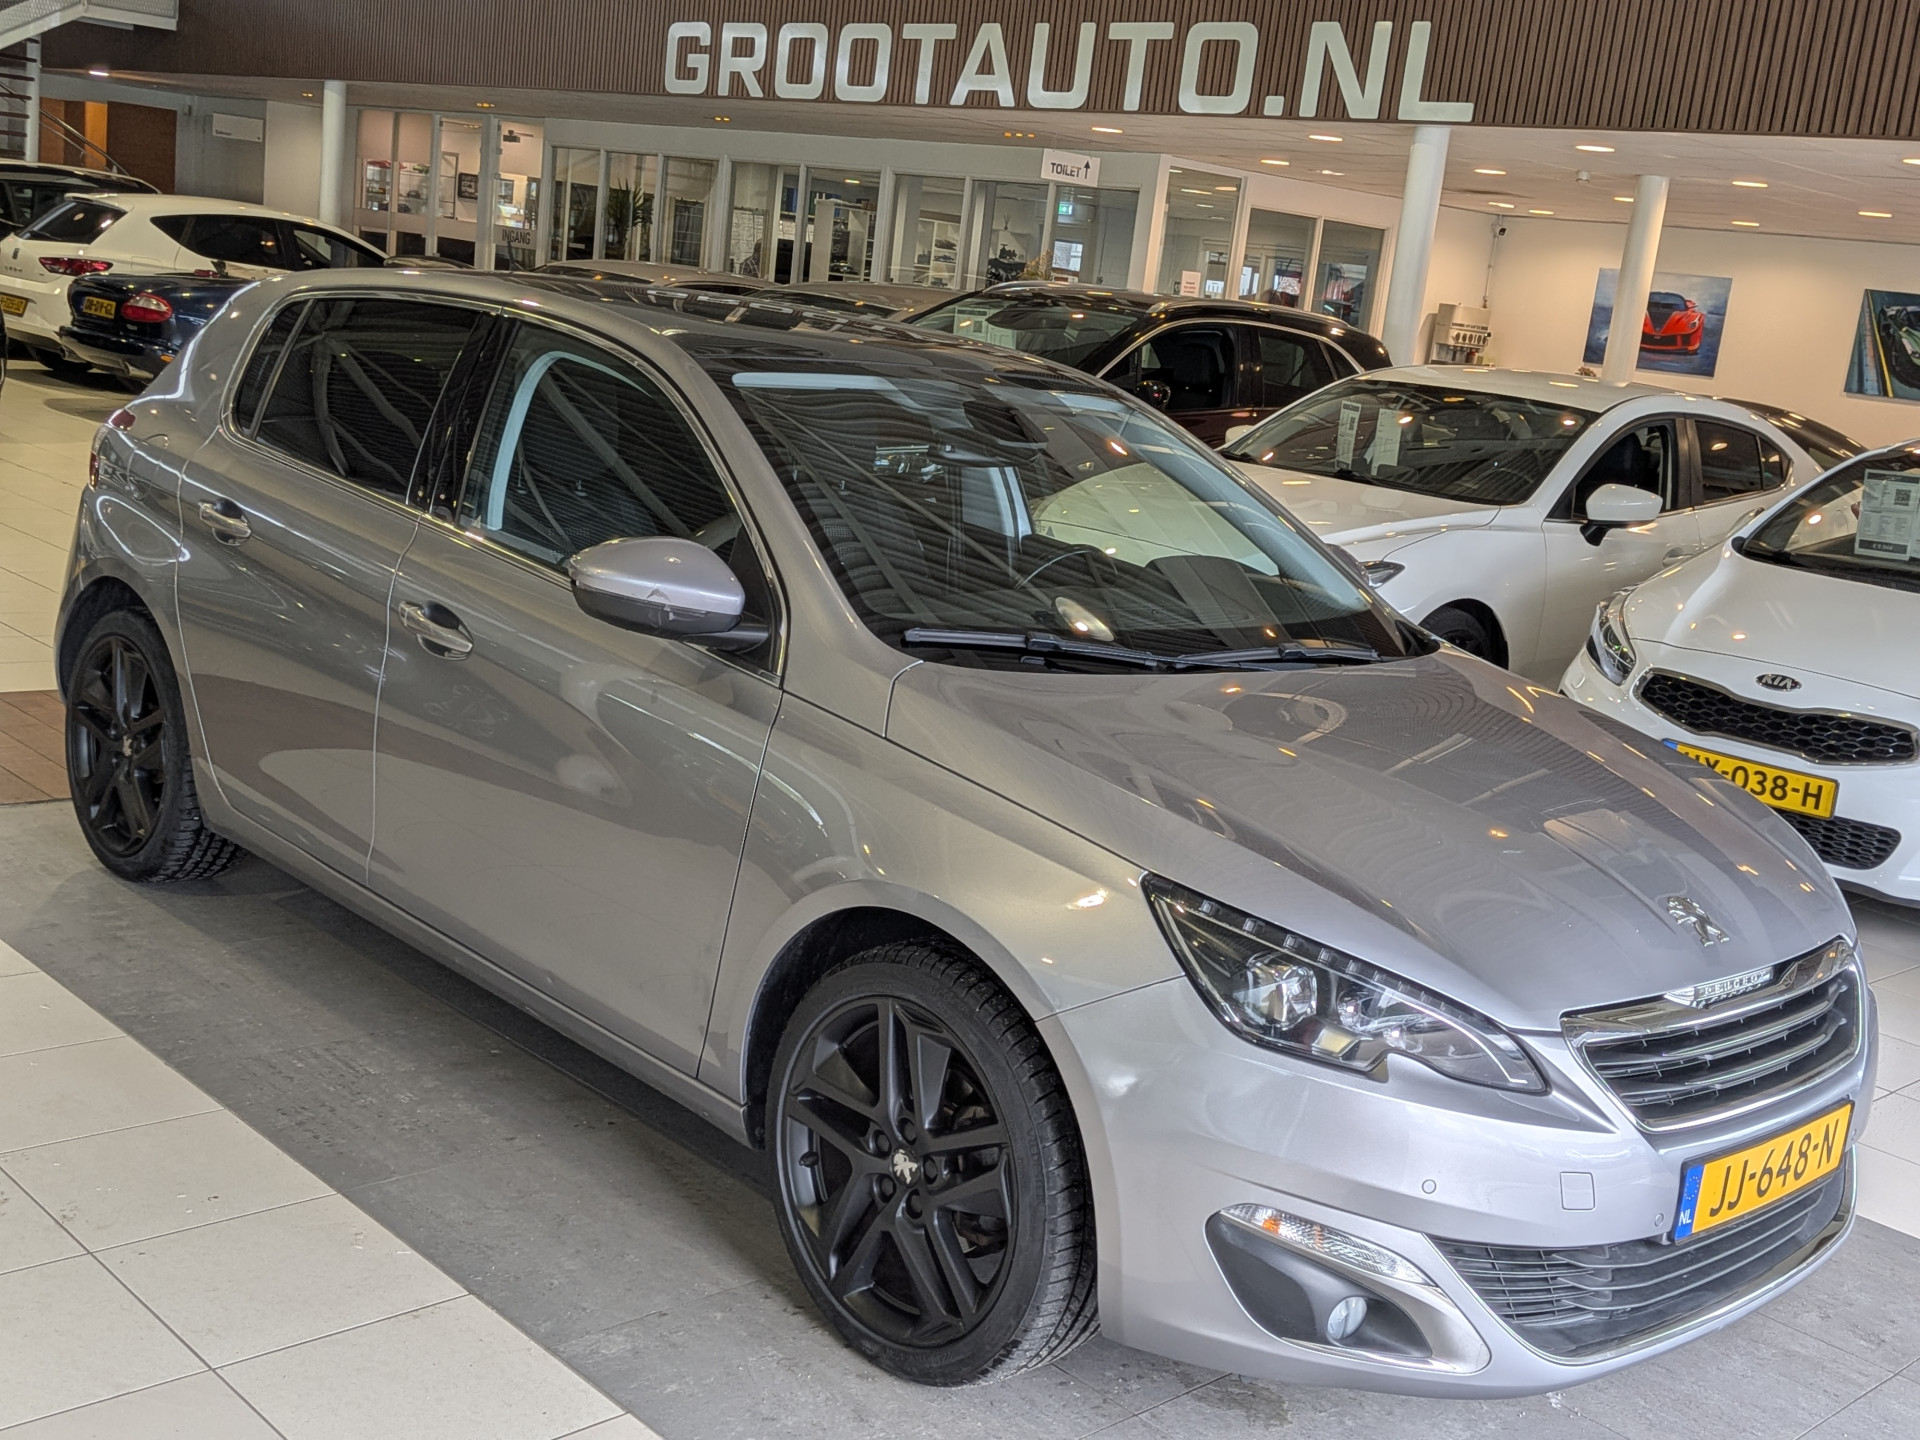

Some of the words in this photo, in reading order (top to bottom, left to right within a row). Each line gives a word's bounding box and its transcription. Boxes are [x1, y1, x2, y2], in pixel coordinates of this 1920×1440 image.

[664, 20, 1475, 122] GROOTAUTO.NL
[1050, 162, 1082, 178] TOILET
[502, 228, 531, 245] INGANG
[1761, 674, 1793, 690] KIA
[1684, 751, 1823, 811] -038-H
[1709, 1119, 1840, 1218] JJ-648-N
[1678, 1209, 1692, 1227] NL
